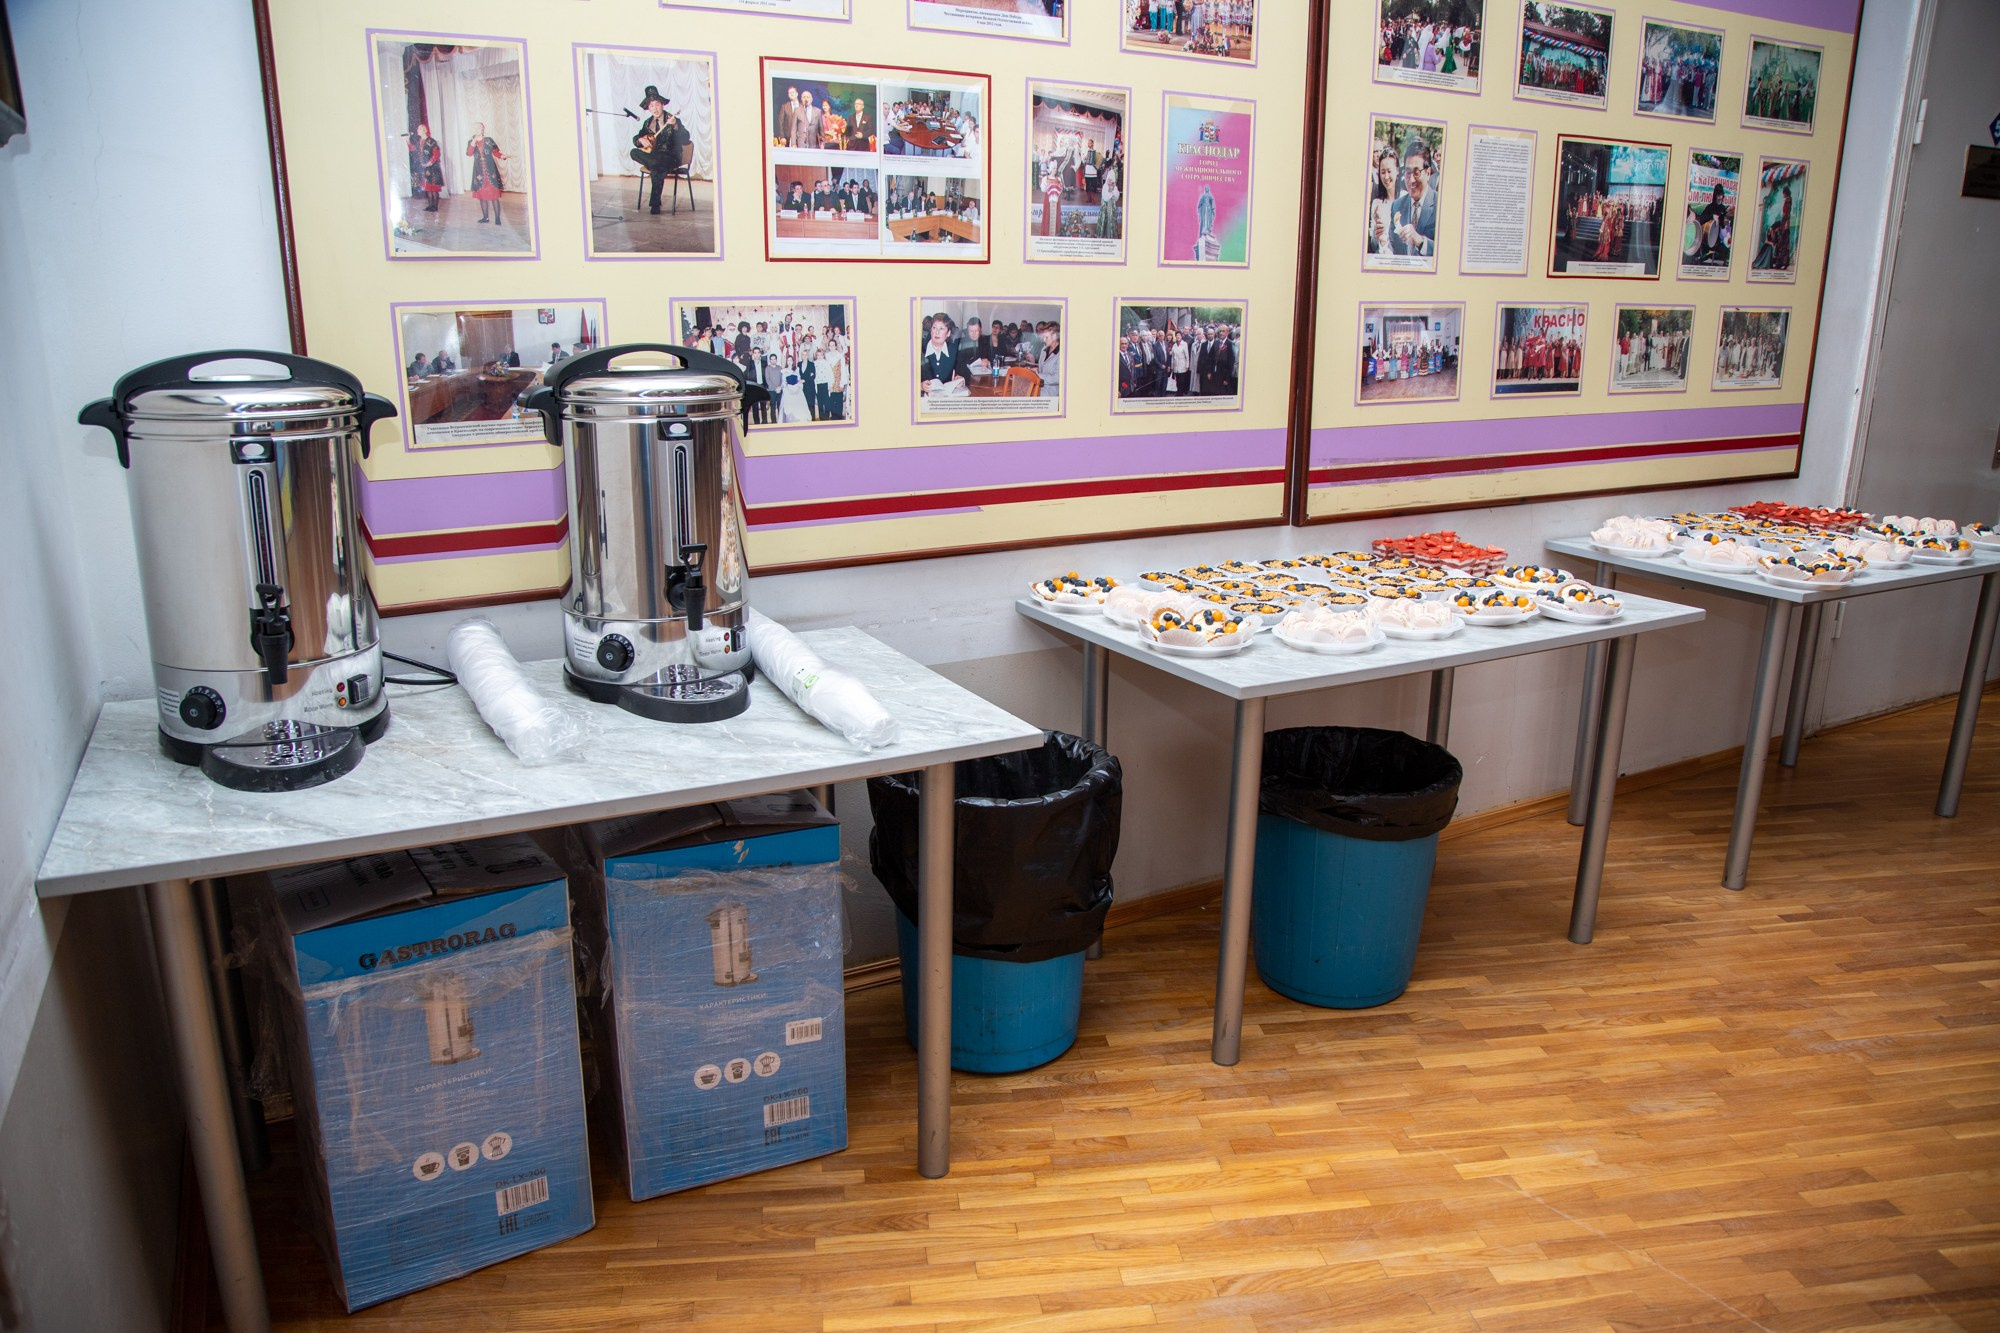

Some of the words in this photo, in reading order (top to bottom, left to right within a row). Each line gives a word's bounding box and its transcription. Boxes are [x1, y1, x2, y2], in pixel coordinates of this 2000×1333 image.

[1177, 143, 1240, 159] КРАСНОДАР
[358, 922, 517, 970] GASTRORAG
[700, 992, 768, 1010] ХАРАКТЕРИСТИКИ:
[414, 1067, 494, 1094] ХАРАКТЕРИСТИКИ:
